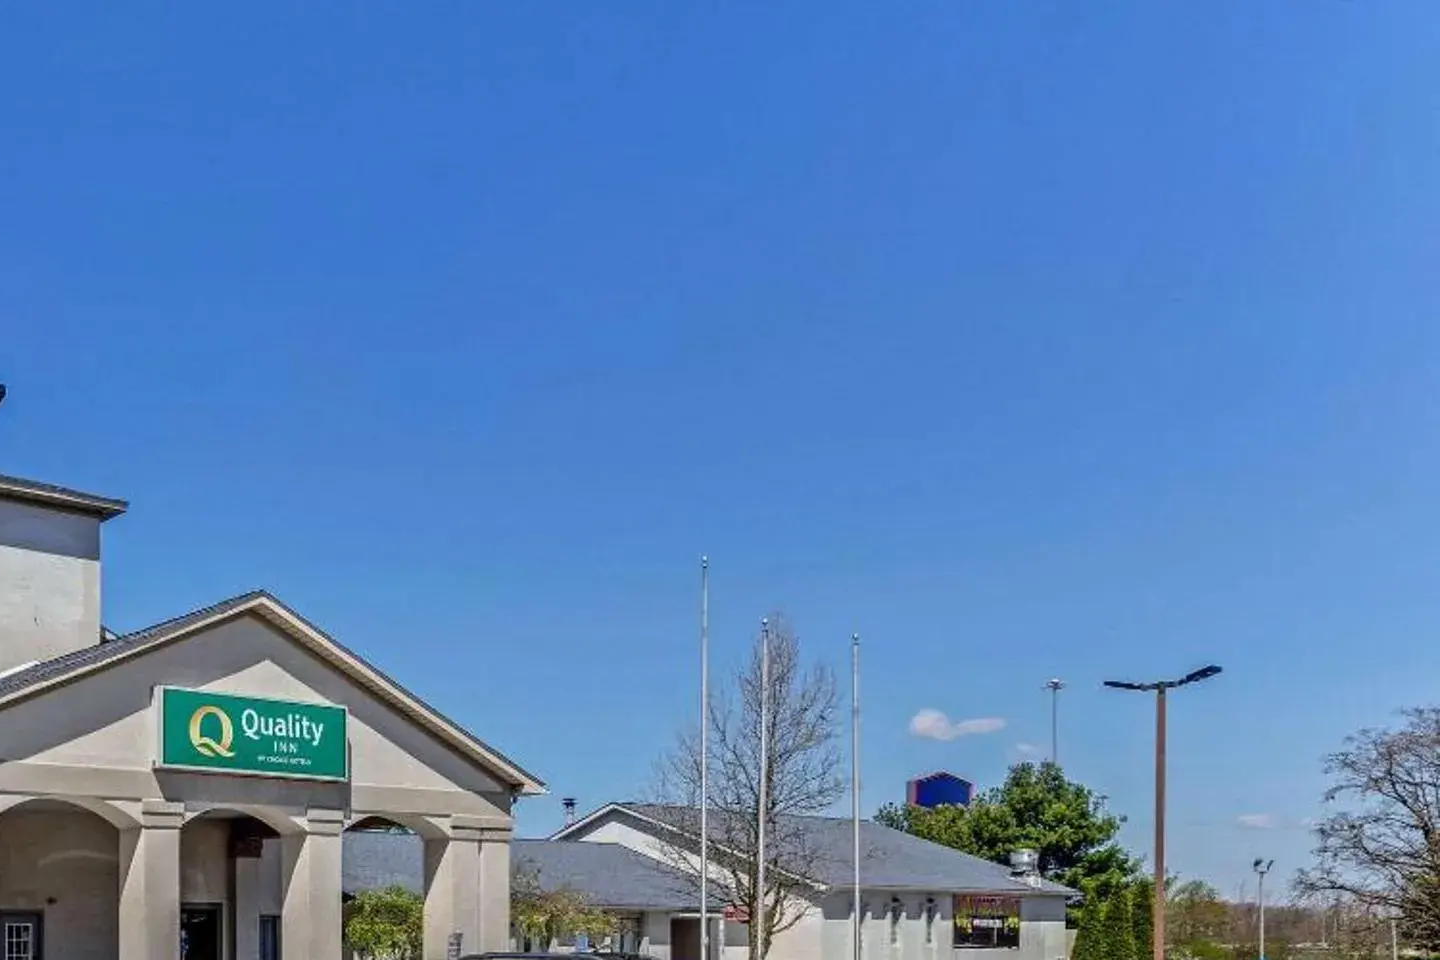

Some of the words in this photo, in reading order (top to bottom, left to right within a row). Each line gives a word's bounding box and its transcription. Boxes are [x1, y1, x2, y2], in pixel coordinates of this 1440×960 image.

[189, 705, 237, 757] Q
[241, 708, 324, 746] Quality
[273, 740, 298, 754] INN
